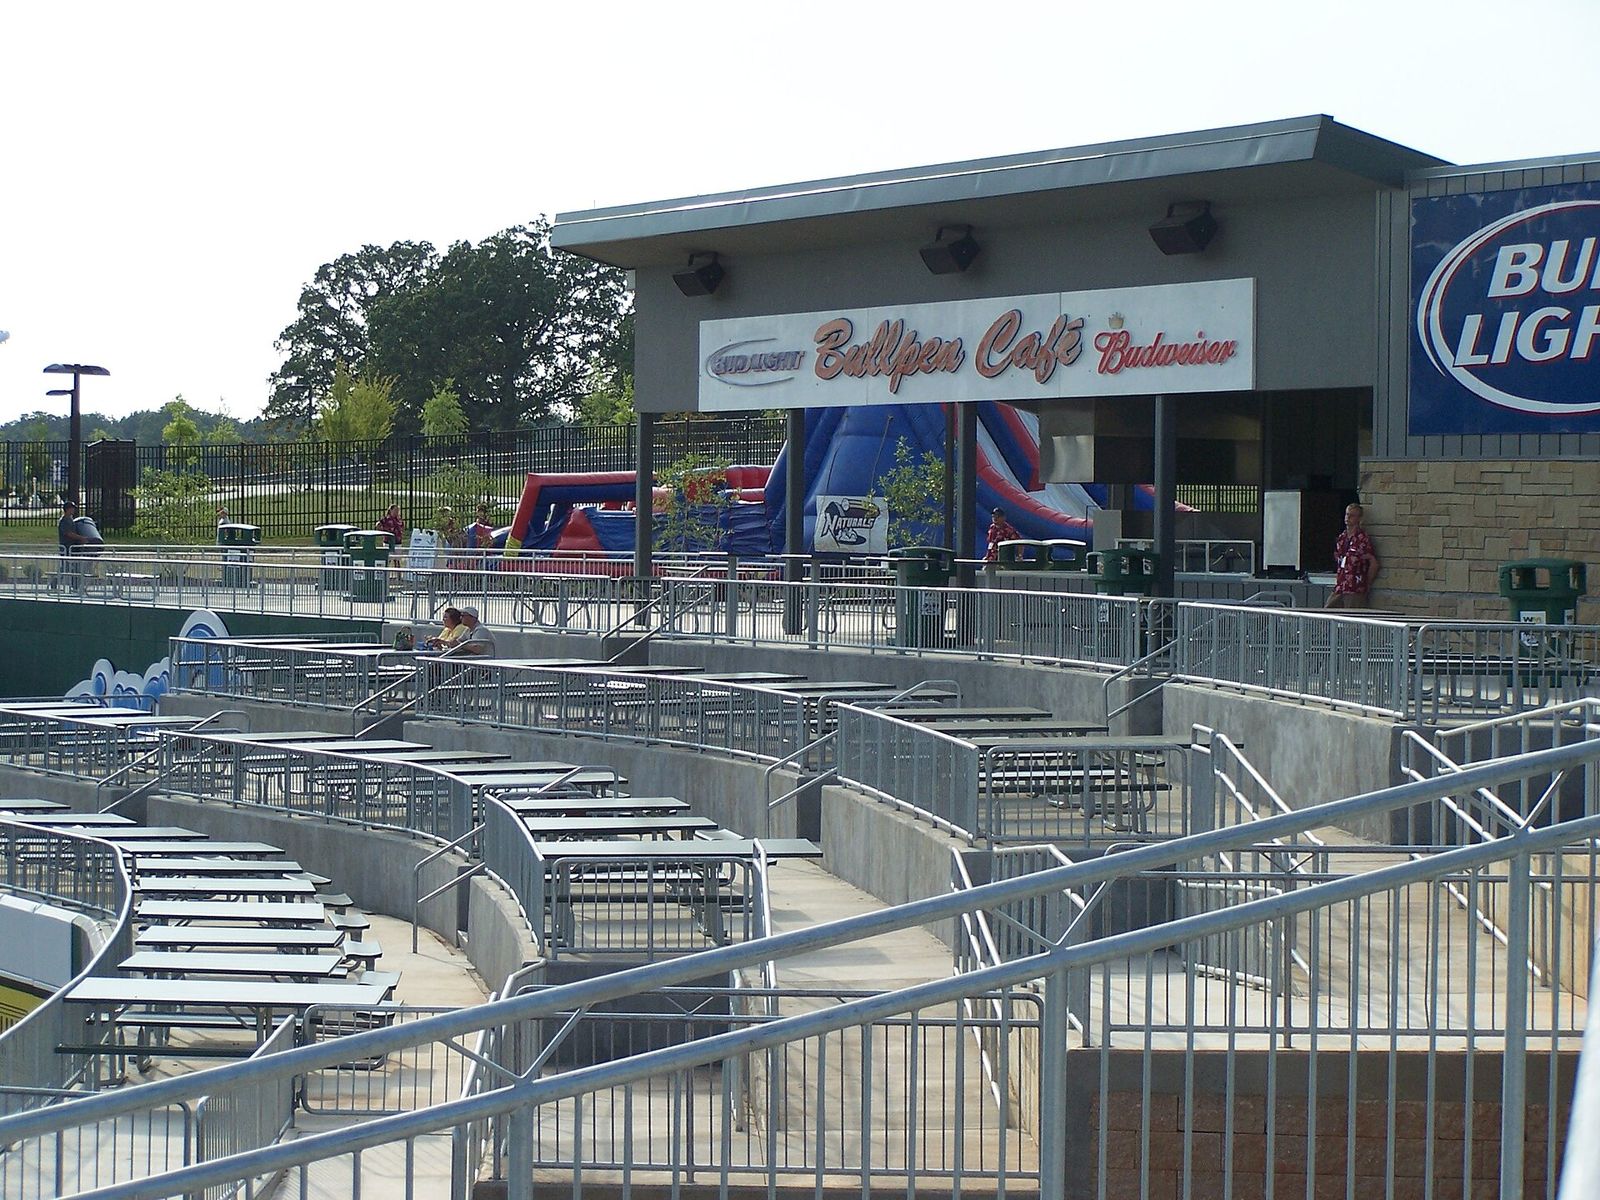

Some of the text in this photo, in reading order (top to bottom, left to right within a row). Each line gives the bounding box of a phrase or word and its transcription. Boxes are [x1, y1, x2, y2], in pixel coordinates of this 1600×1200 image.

[1487, 236, 1600, 298] BU
[711, 350, 806, 375] BUD LIGHT
[813, 308, 1084, 394] Bullpen Café
[1094, 329, 1238, 375] Budweiser
